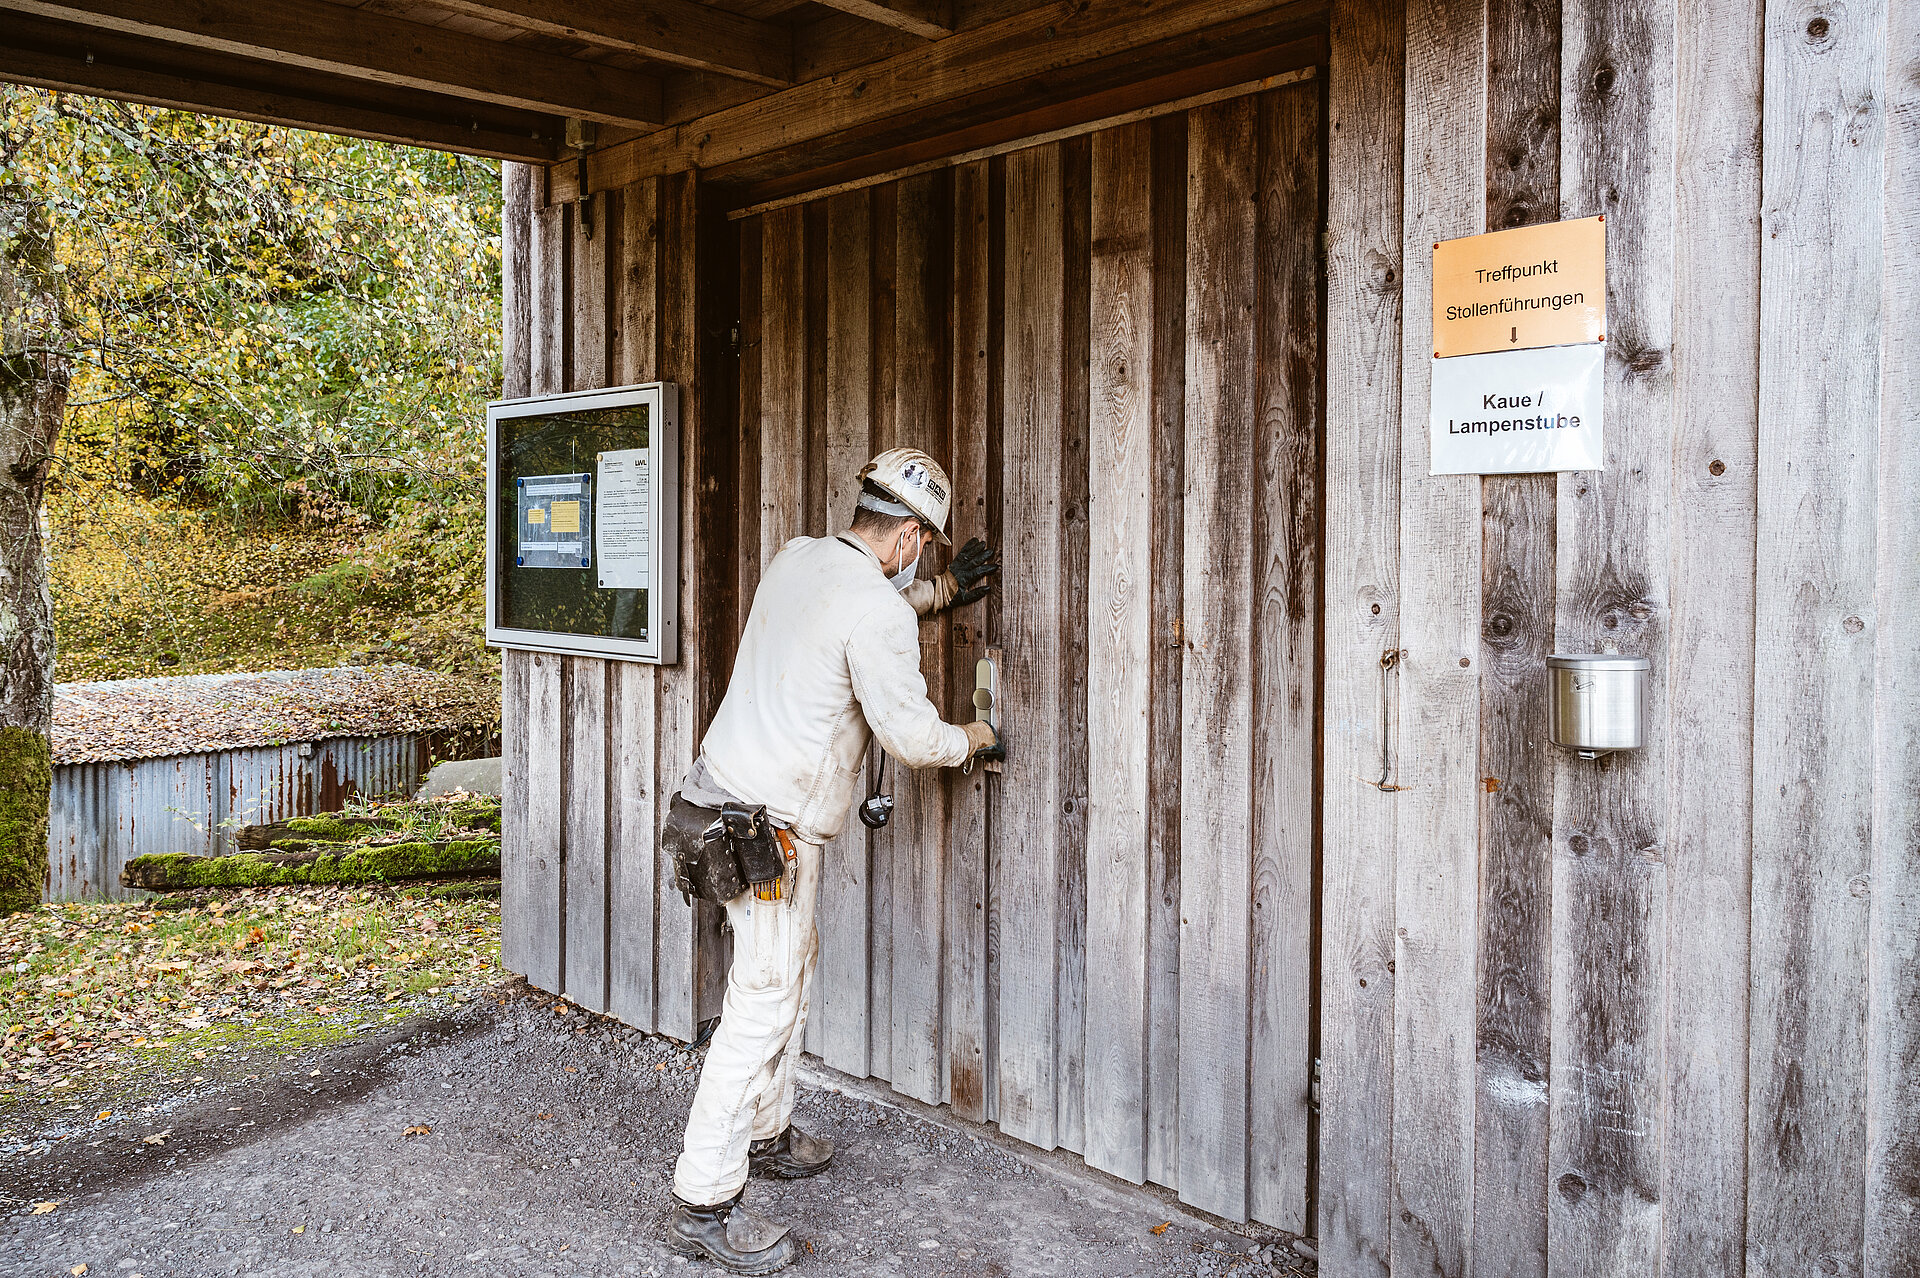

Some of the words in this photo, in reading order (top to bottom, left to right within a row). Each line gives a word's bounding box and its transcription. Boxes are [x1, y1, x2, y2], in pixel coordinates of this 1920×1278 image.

[1475, 259, 1559, 284] Treffpunkt
[1446, 291, 1585, 321] Stollenführungen
[1483, 393, 1532, 410] Kaue
[1537, 391, 1544, 407] /
[1449, 413, 1581, 436] Lampenstube
[635, 459, 647, 467] LWL
[927, 479, 947, 501] RAG
